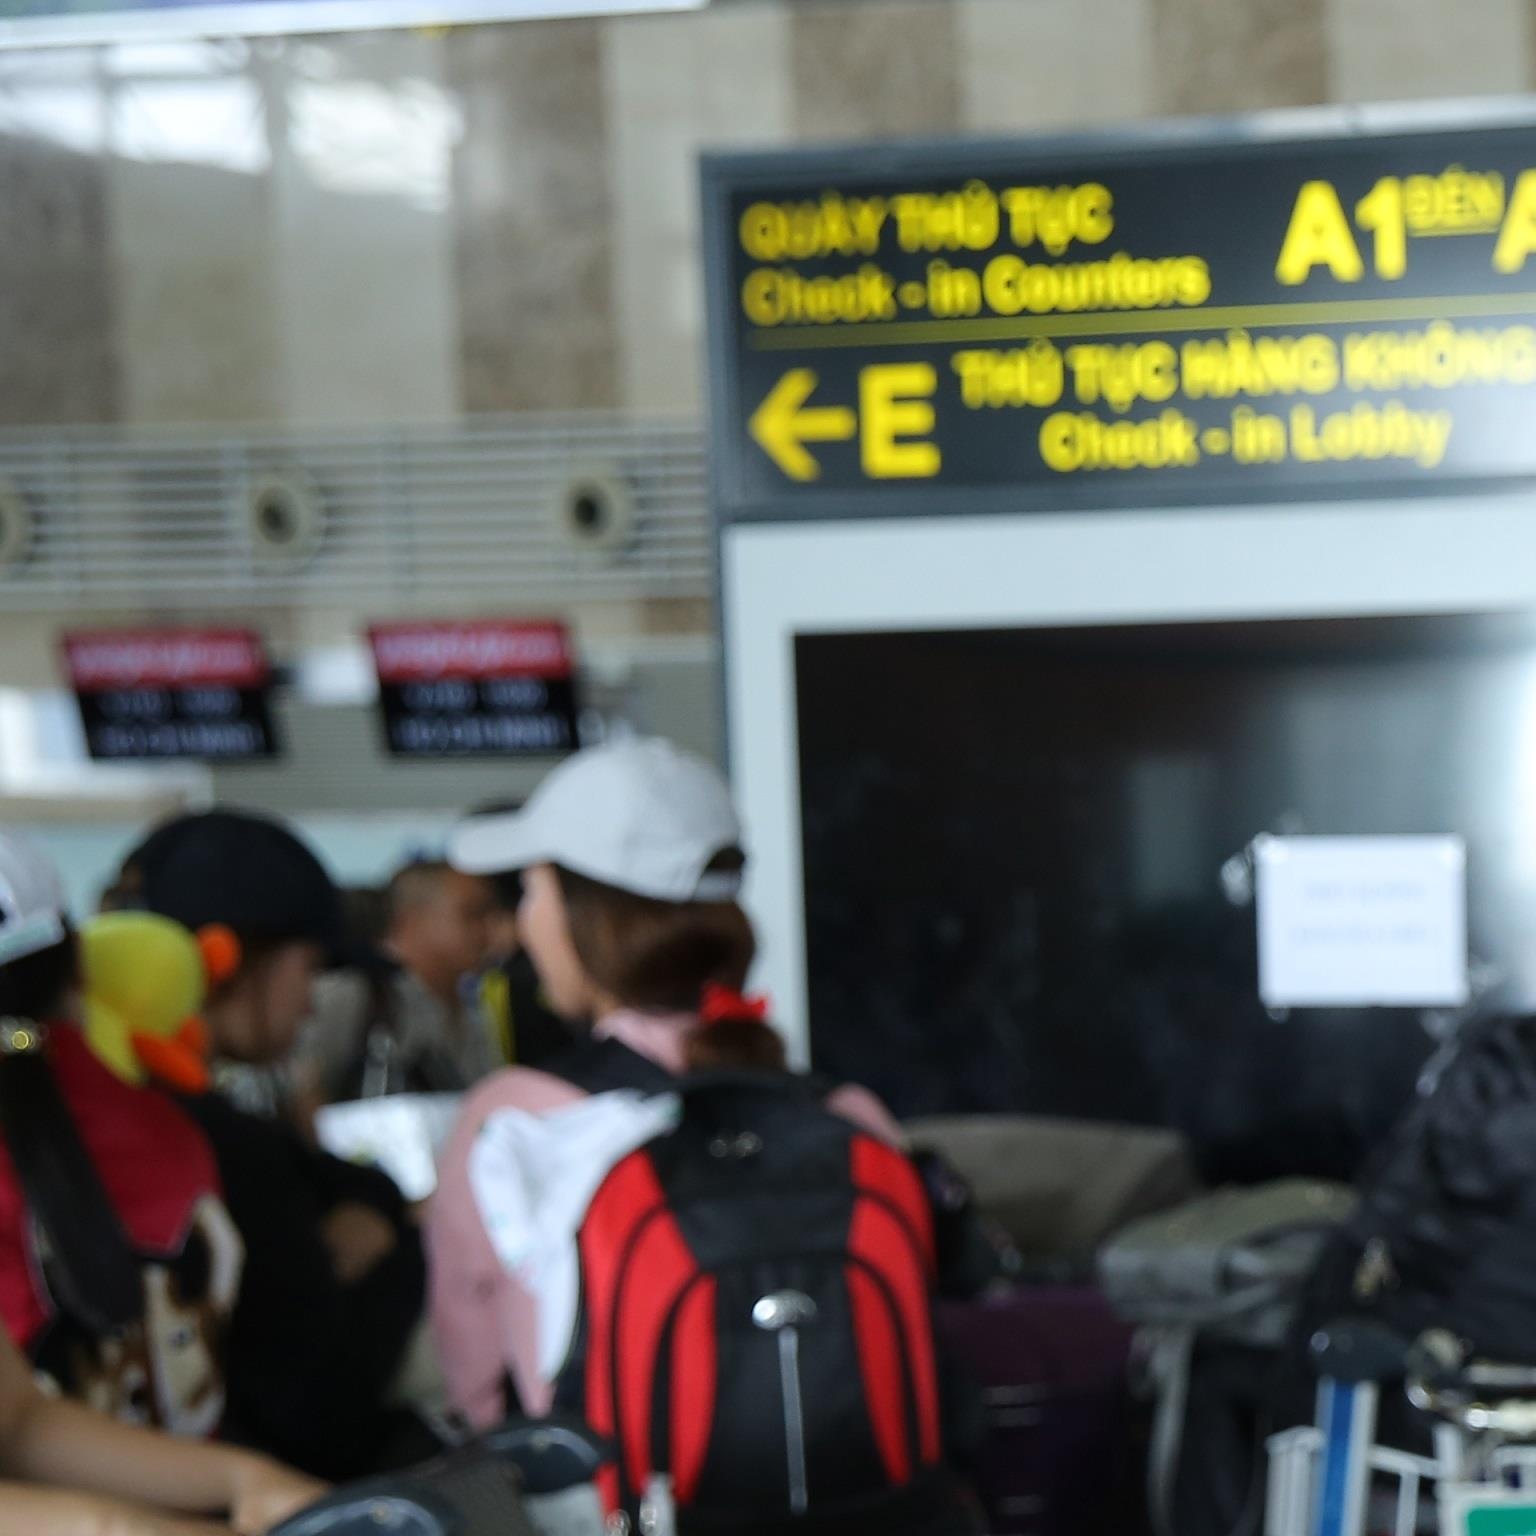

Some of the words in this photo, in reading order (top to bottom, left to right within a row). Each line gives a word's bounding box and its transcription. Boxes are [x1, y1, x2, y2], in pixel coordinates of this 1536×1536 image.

[1274, 175, 1407, 286] A1
[742, 264, 897, 327] Check
[983, 250, 1211, 316] Counters
[859, 361, 942, 479] E
[1039, 409, 1200, 471] Check
[1290, 399, 1452, 468] Lobby
